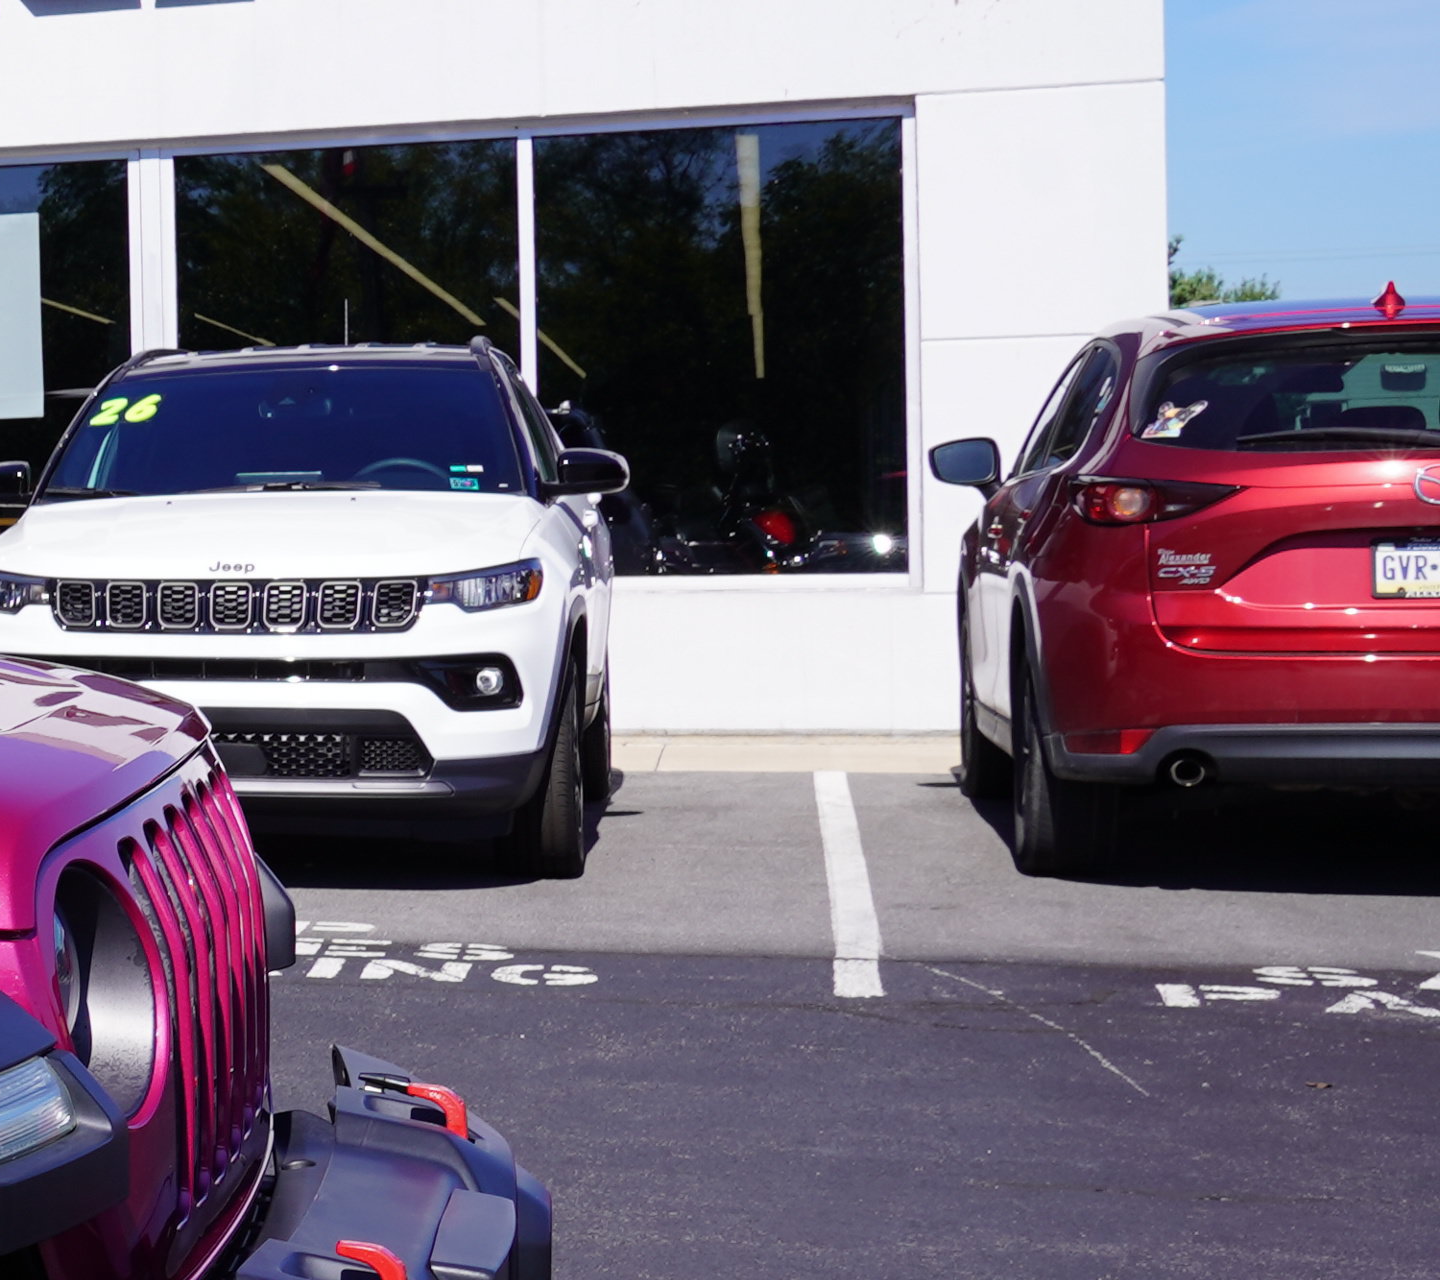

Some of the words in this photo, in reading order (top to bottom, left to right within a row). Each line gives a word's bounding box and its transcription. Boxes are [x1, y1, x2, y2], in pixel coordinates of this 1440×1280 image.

[89, 393, 162, 427] 26
[208, 560, 256, 575] Jeep
[1158, 565, 1217, 578] CX-5
